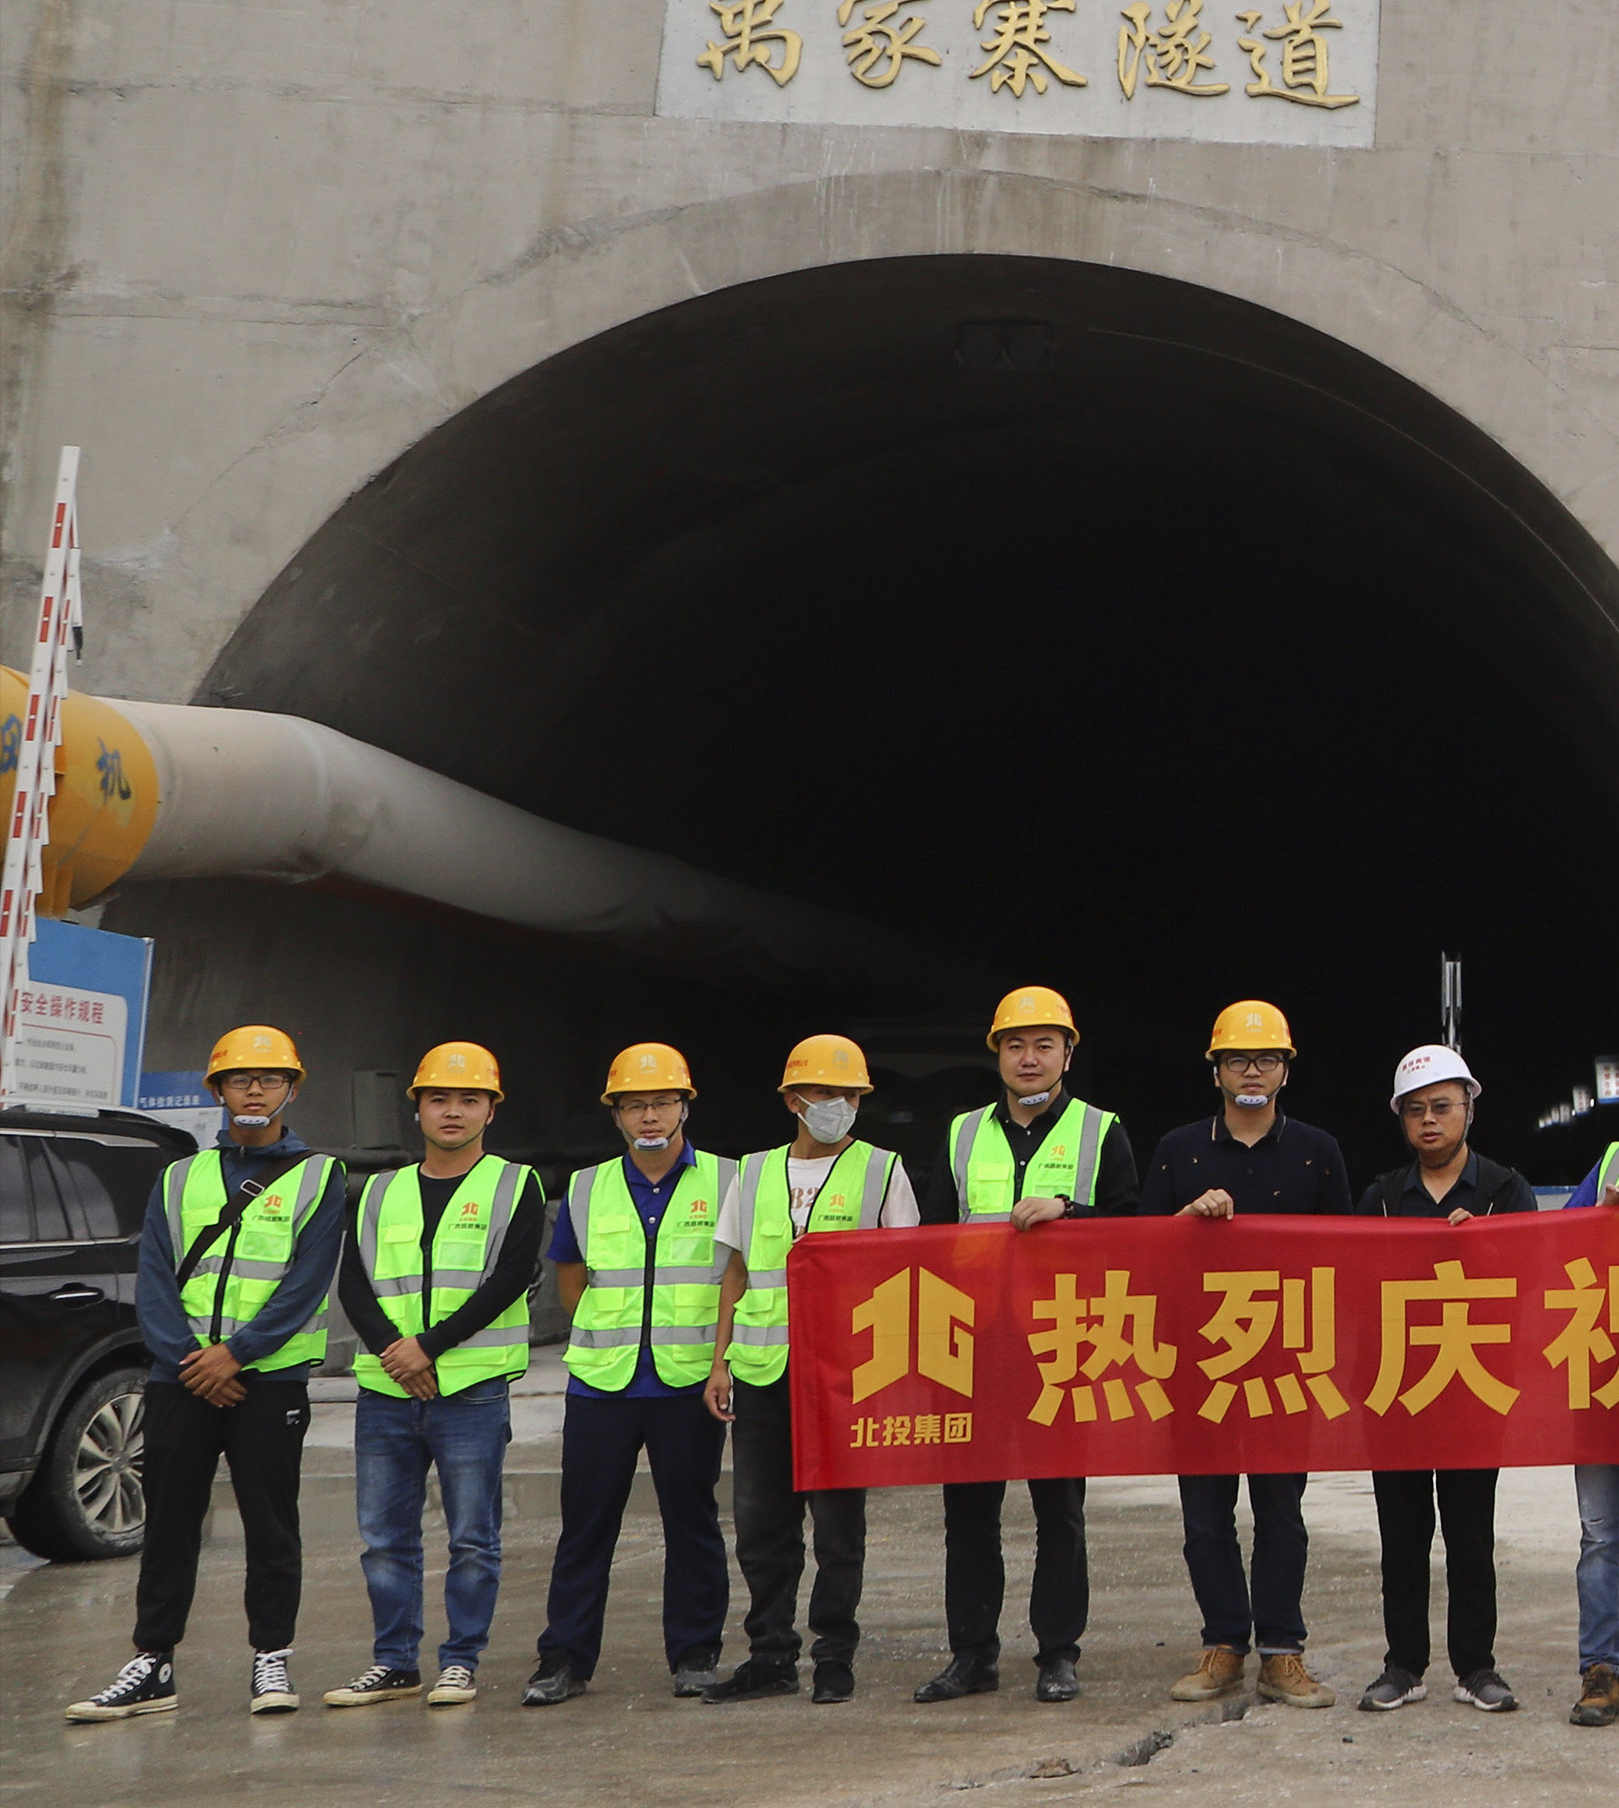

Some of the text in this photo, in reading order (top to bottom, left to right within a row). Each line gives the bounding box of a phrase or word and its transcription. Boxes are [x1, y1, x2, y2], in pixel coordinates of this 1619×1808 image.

[21, 991, 104, 1025] 安全操作规程
[850, 1412, 973, 1449] 北投集团
